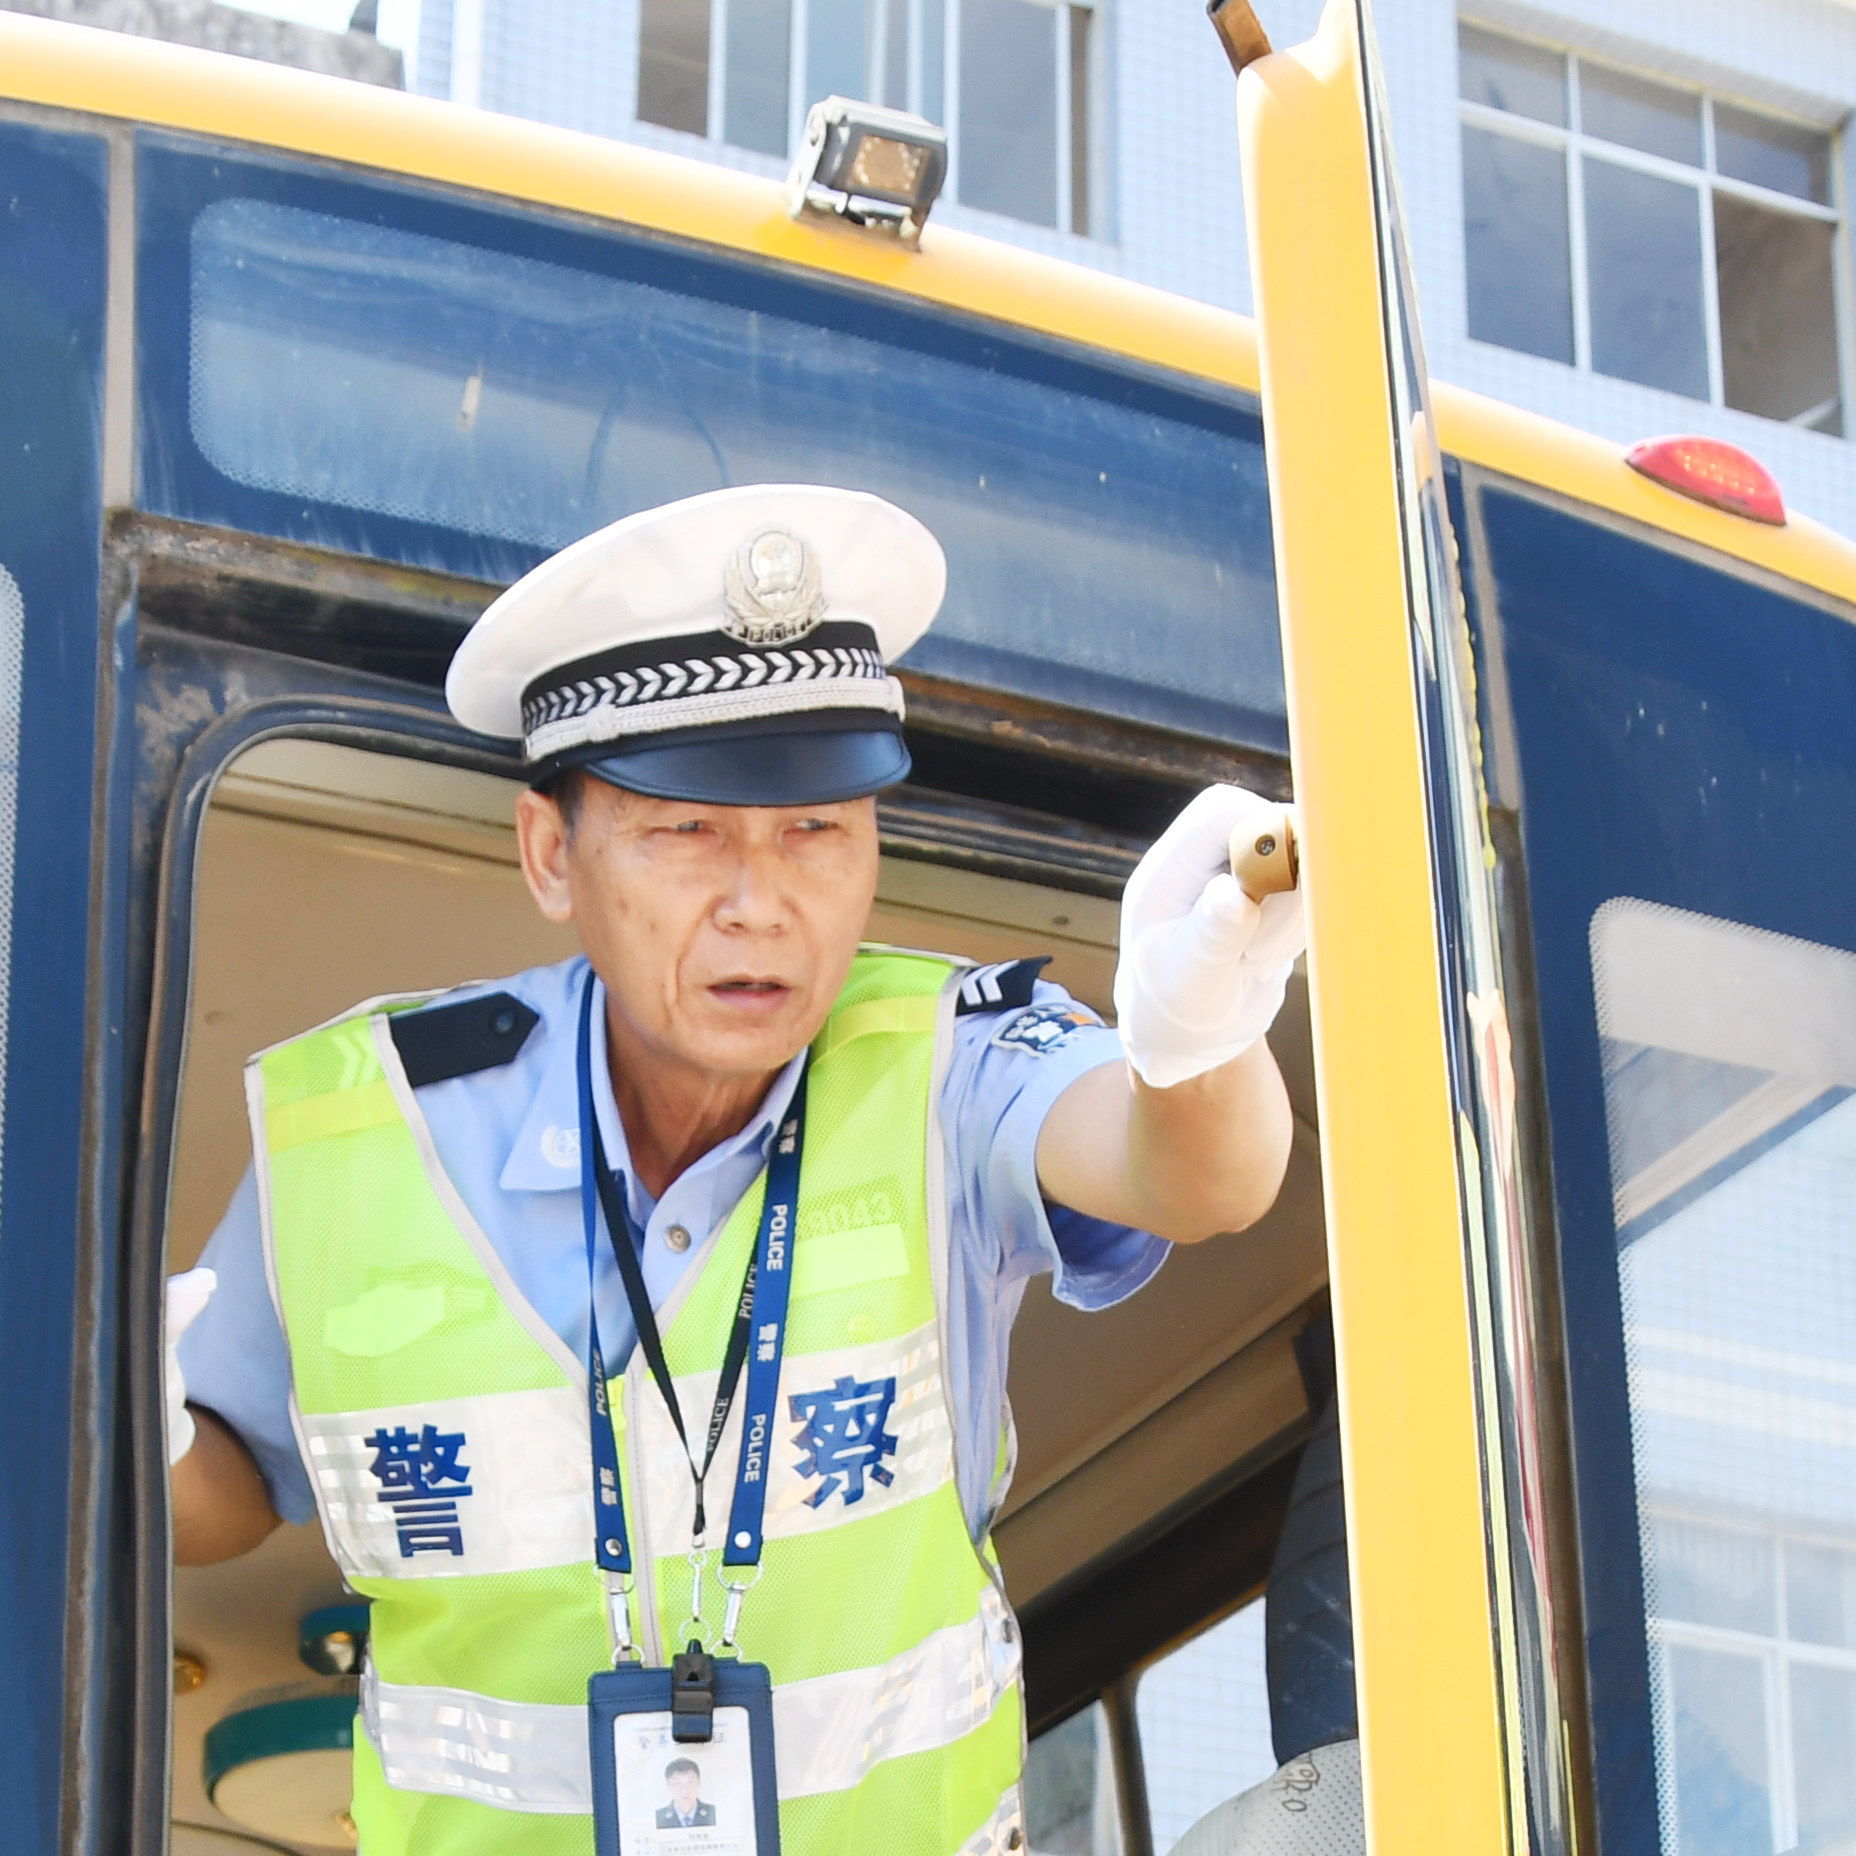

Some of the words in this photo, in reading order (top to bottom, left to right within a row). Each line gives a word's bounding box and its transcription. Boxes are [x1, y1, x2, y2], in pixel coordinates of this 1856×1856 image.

[766, 1203, 788, 1271] POLICE
[364, 1423, 473, 1559] 警
[787, 1375, 900, 1511] 察
[744, 1412, 767, 1485] POLICE
